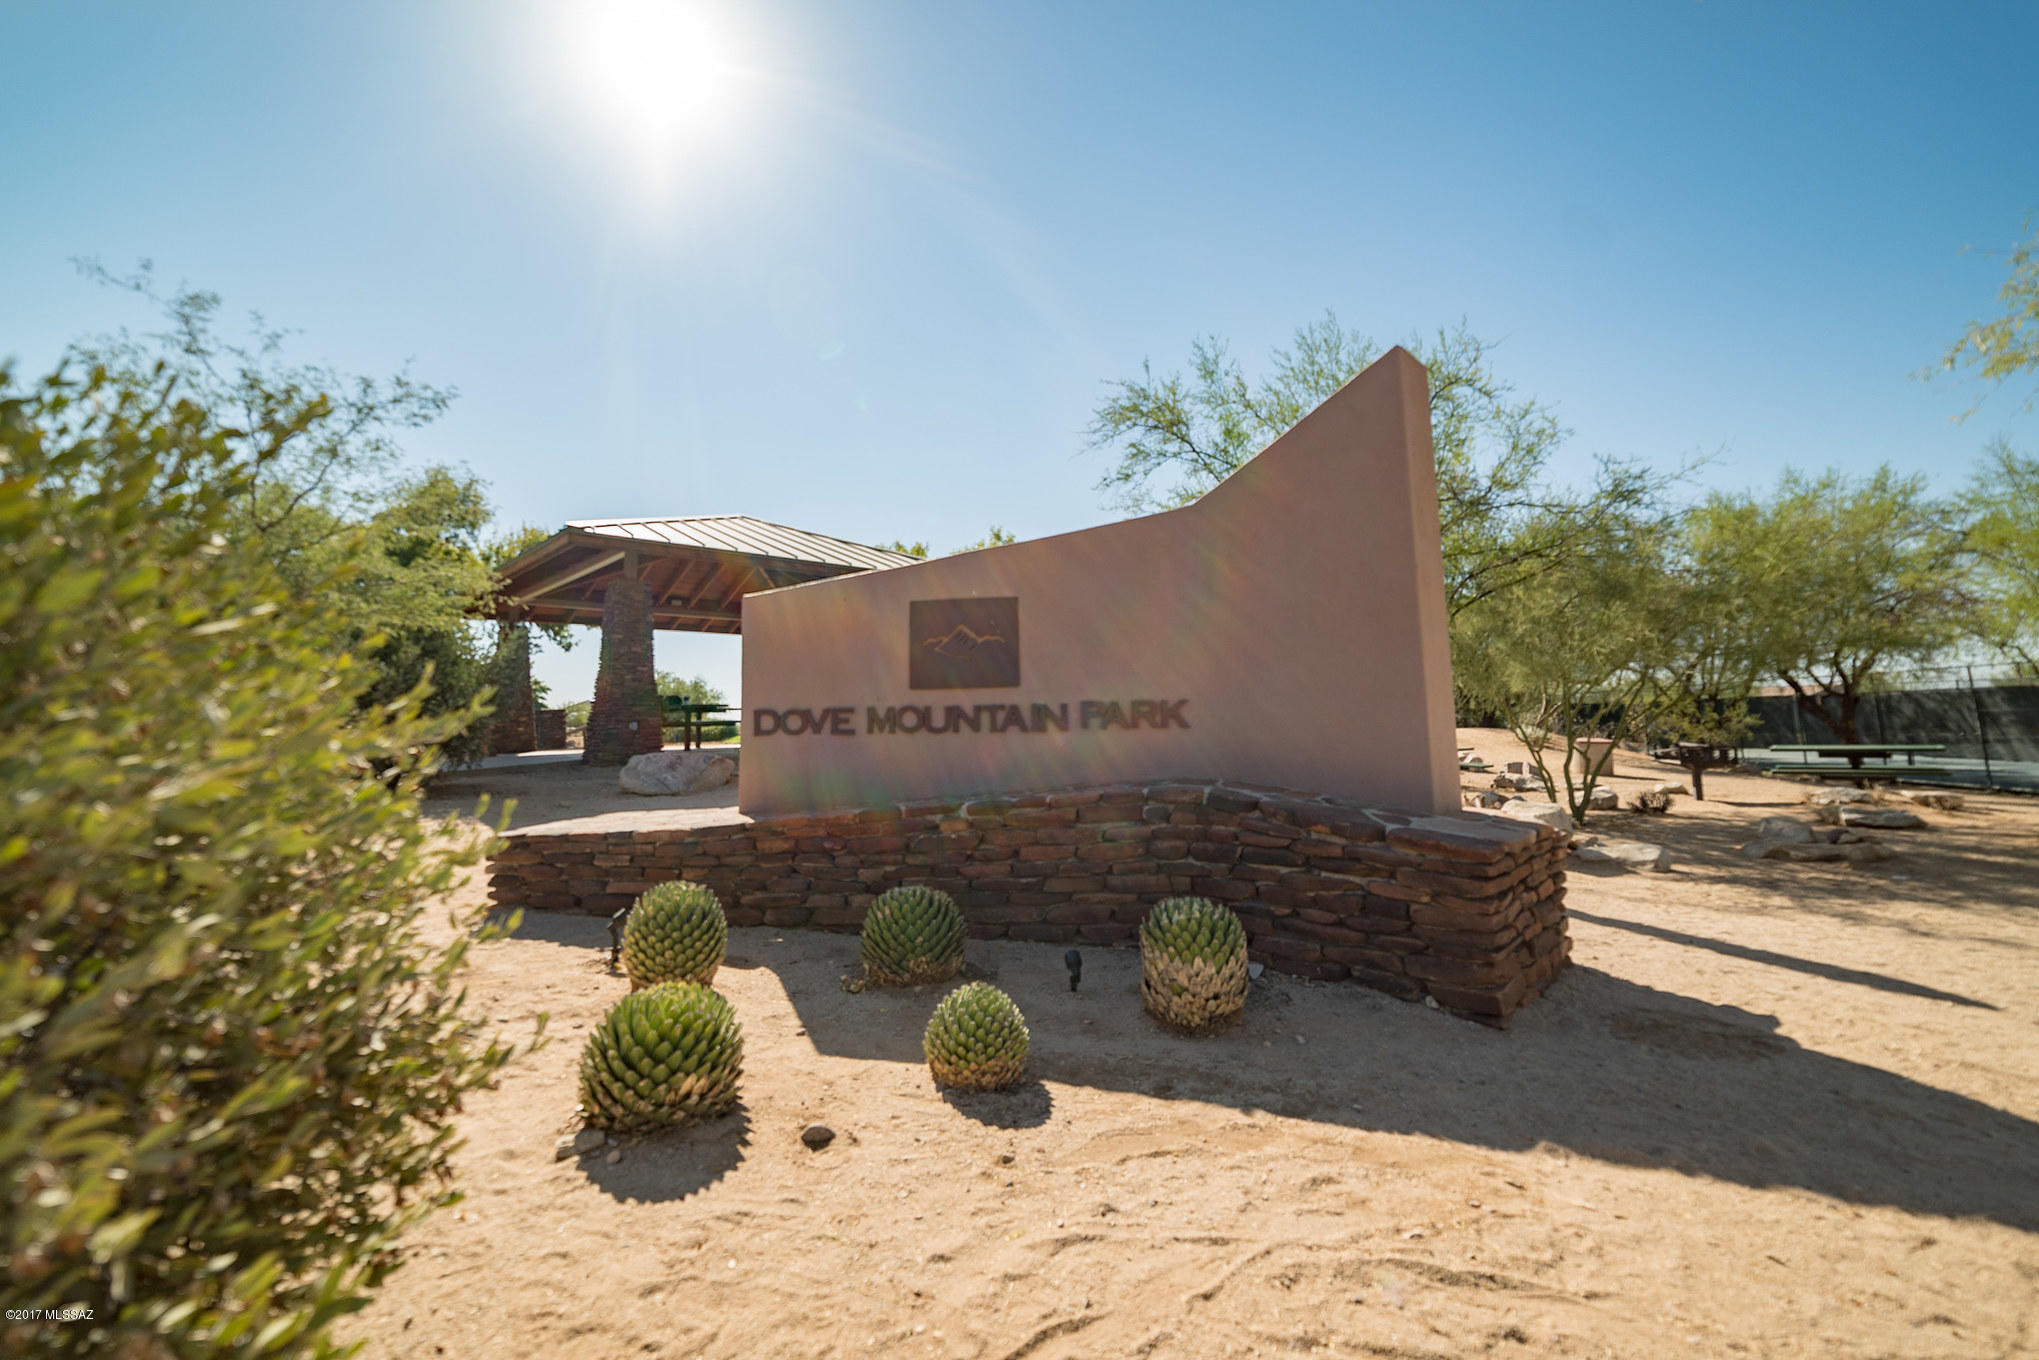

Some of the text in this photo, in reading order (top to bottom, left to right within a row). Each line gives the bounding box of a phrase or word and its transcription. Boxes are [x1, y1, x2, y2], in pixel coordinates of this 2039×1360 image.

[753, 699, 1191, 736] DOVE MOUNTAIN PARK
